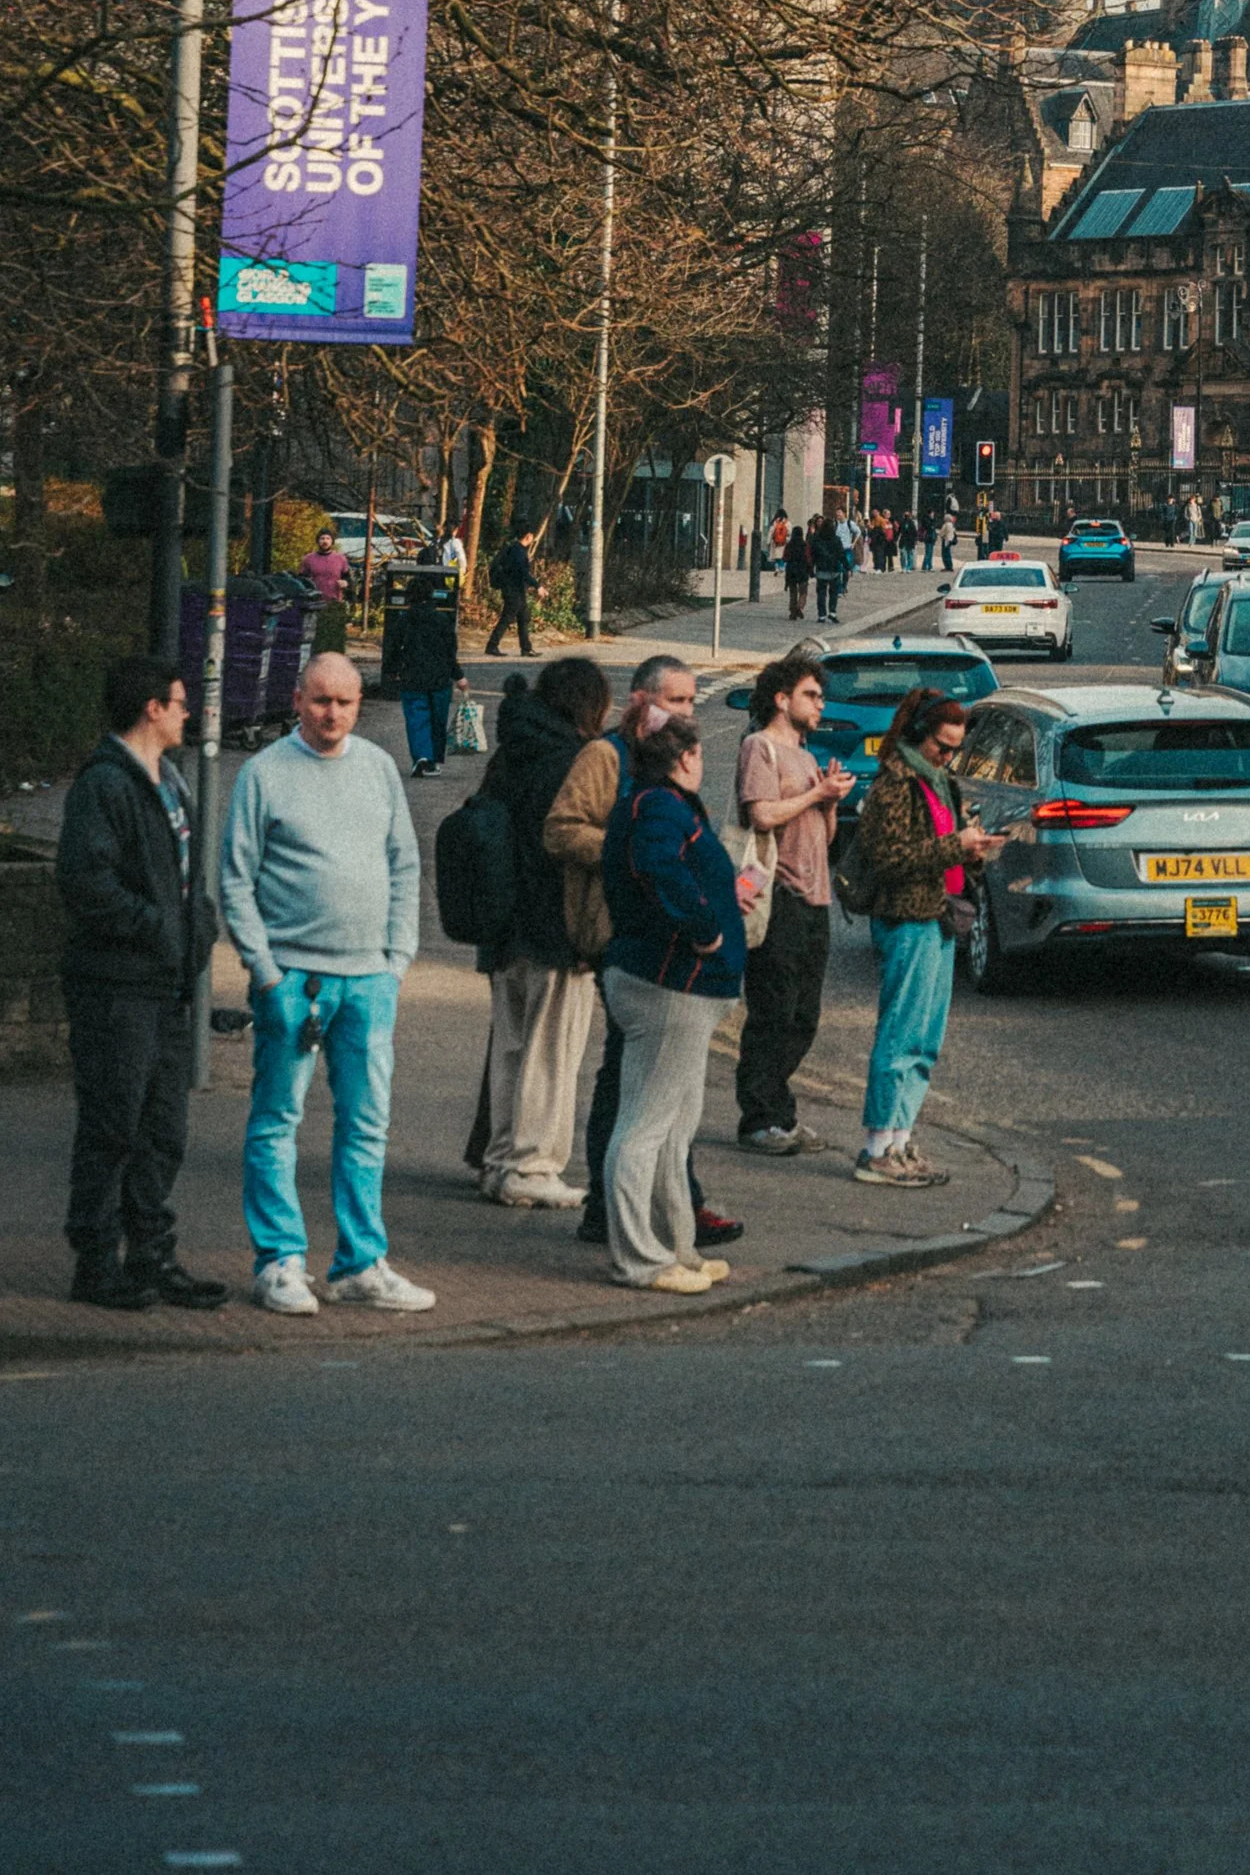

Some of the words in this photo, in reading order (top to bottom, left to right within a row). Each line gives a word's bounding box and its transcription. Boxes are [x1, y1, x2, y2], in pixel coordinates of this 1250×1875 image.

[350, 35, 390, 124] THE
[345, 133, 385, 196] OF
[1211, 858, 1247, 876] VLL
